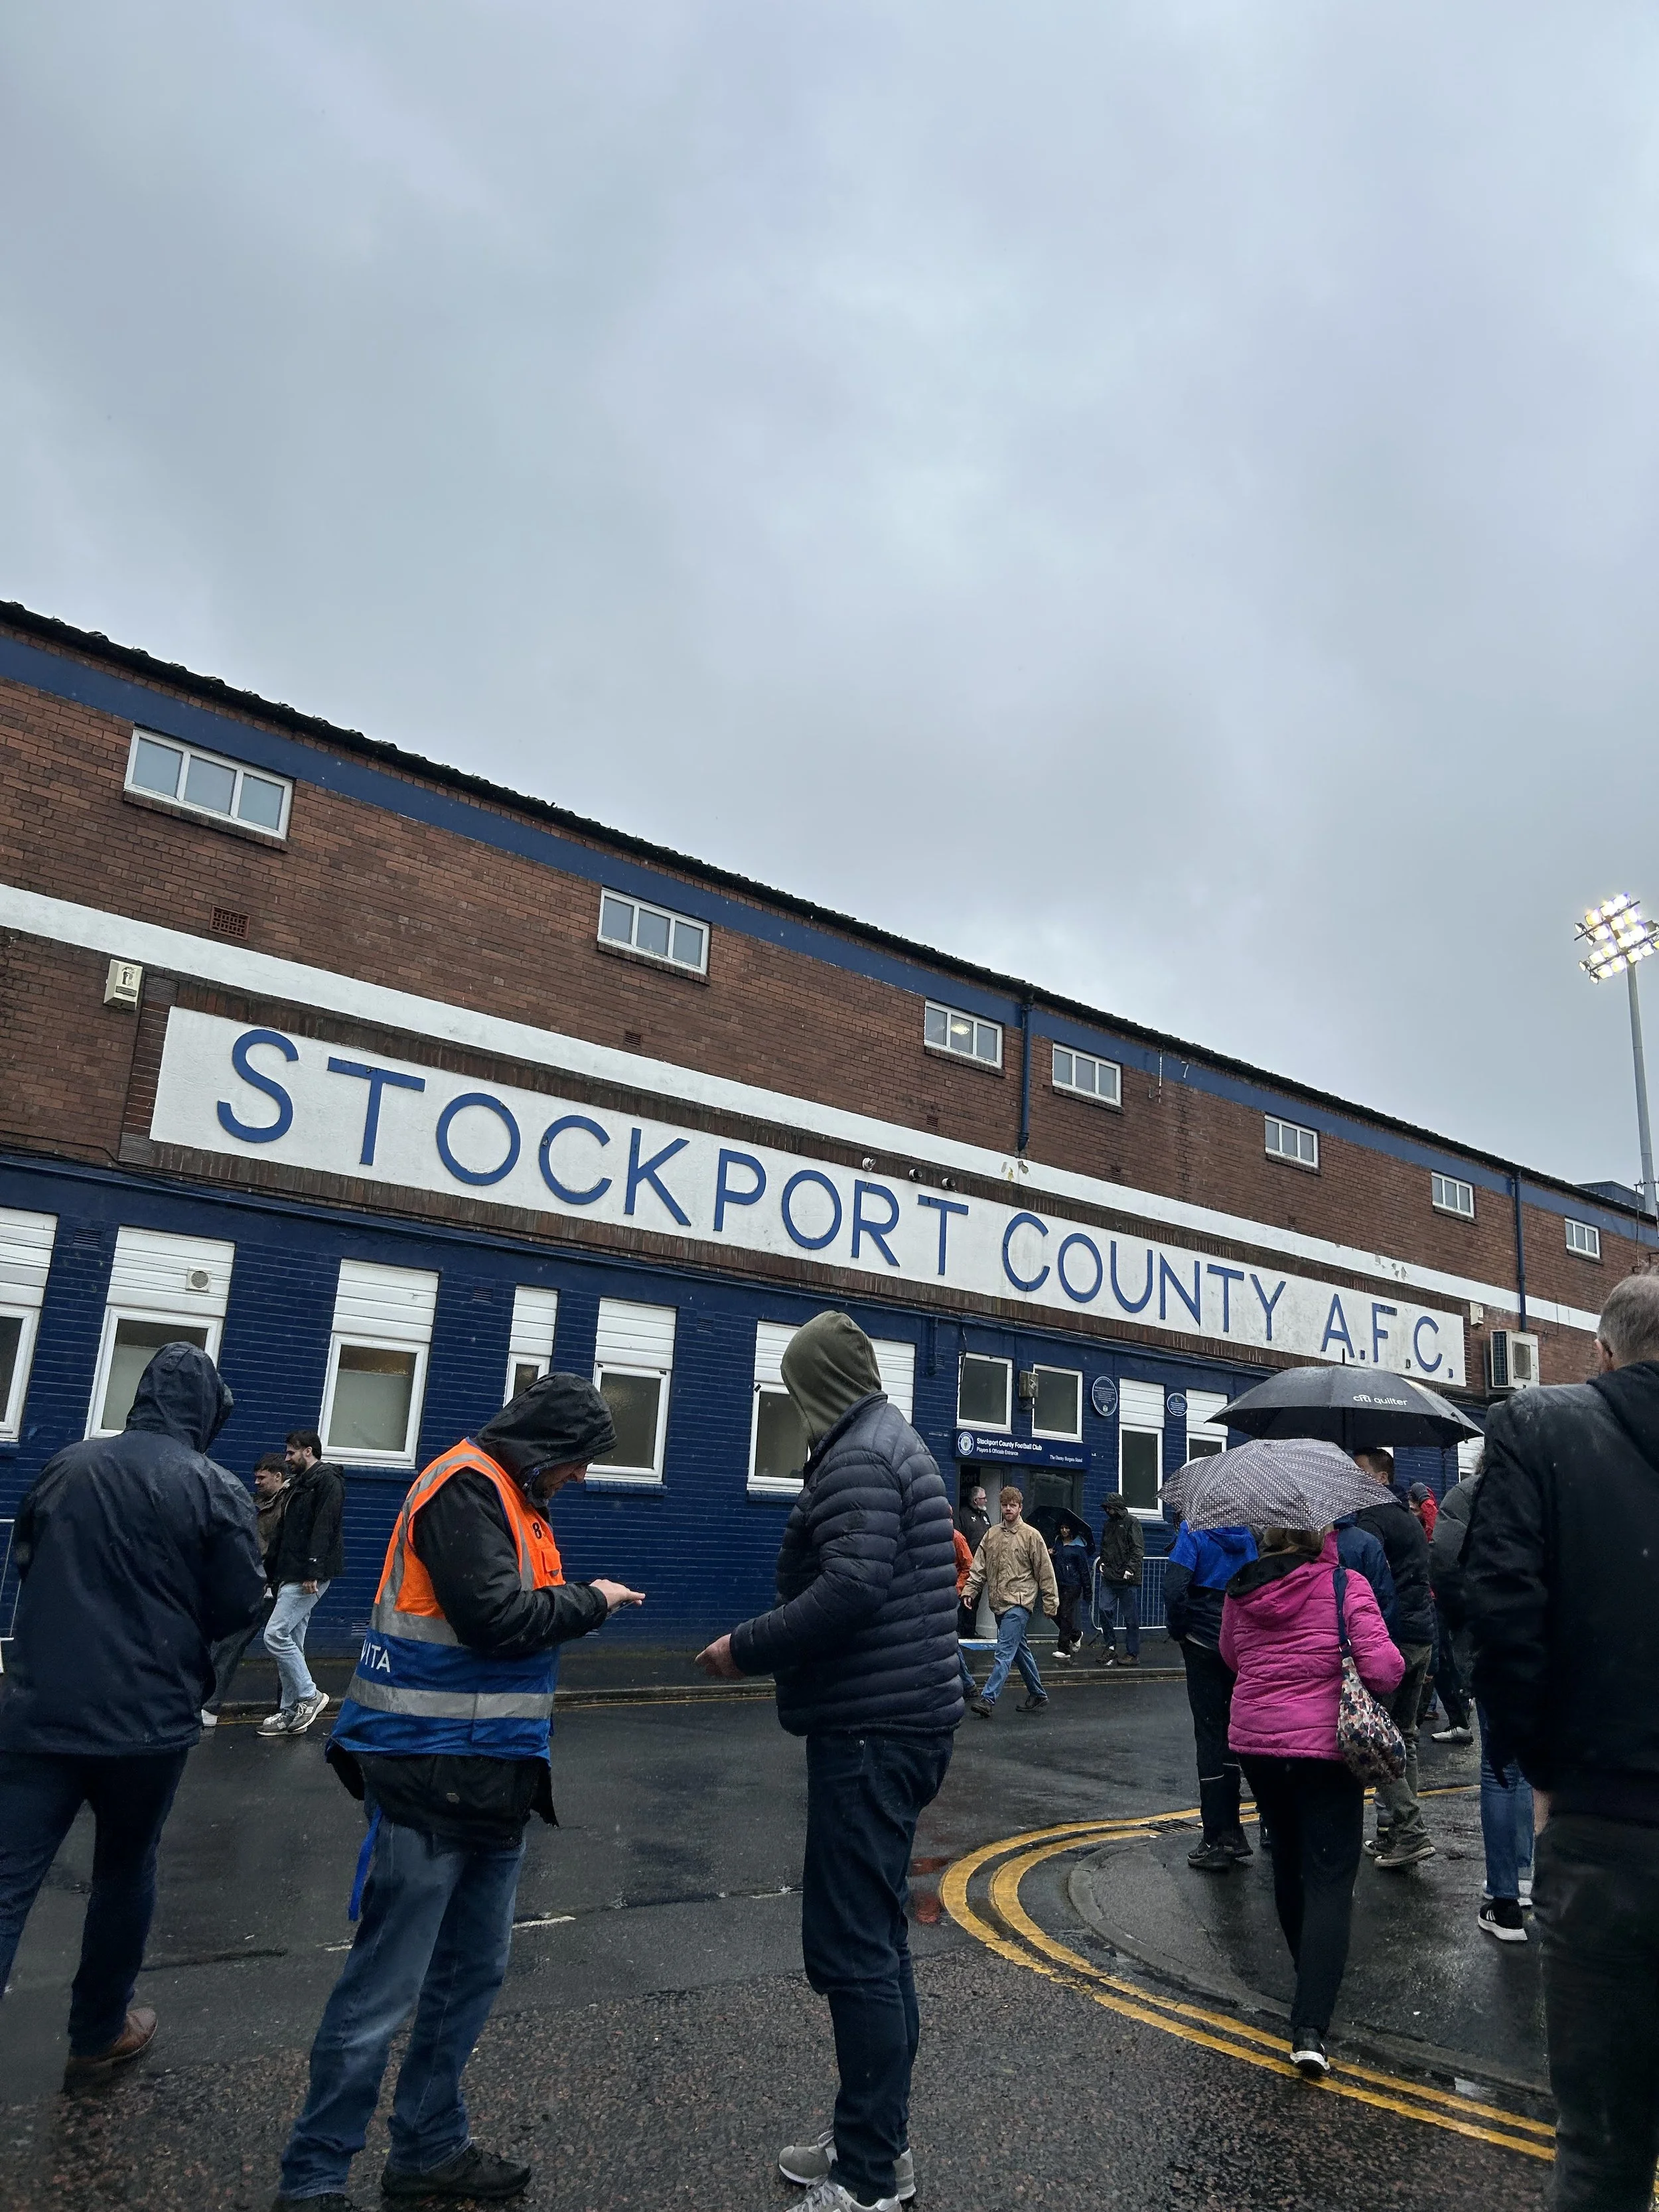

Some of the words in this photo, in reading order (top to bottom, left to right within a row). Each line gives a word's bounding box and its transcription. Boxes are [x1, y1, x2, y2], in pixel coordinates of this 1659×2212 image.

[217, 1029, 969, 1276] STOCKPORT
[1002, 1212, 1286, 1341] COUNTY
[1352, 1394, 1372, 1403] citi
[1373, 1397, 1408, 1406] quilter
[977, 1438, 998, 1446] Stockport
[999, 1440, 1015, 1449] County
[532, 1522, 542, 1540] 8
